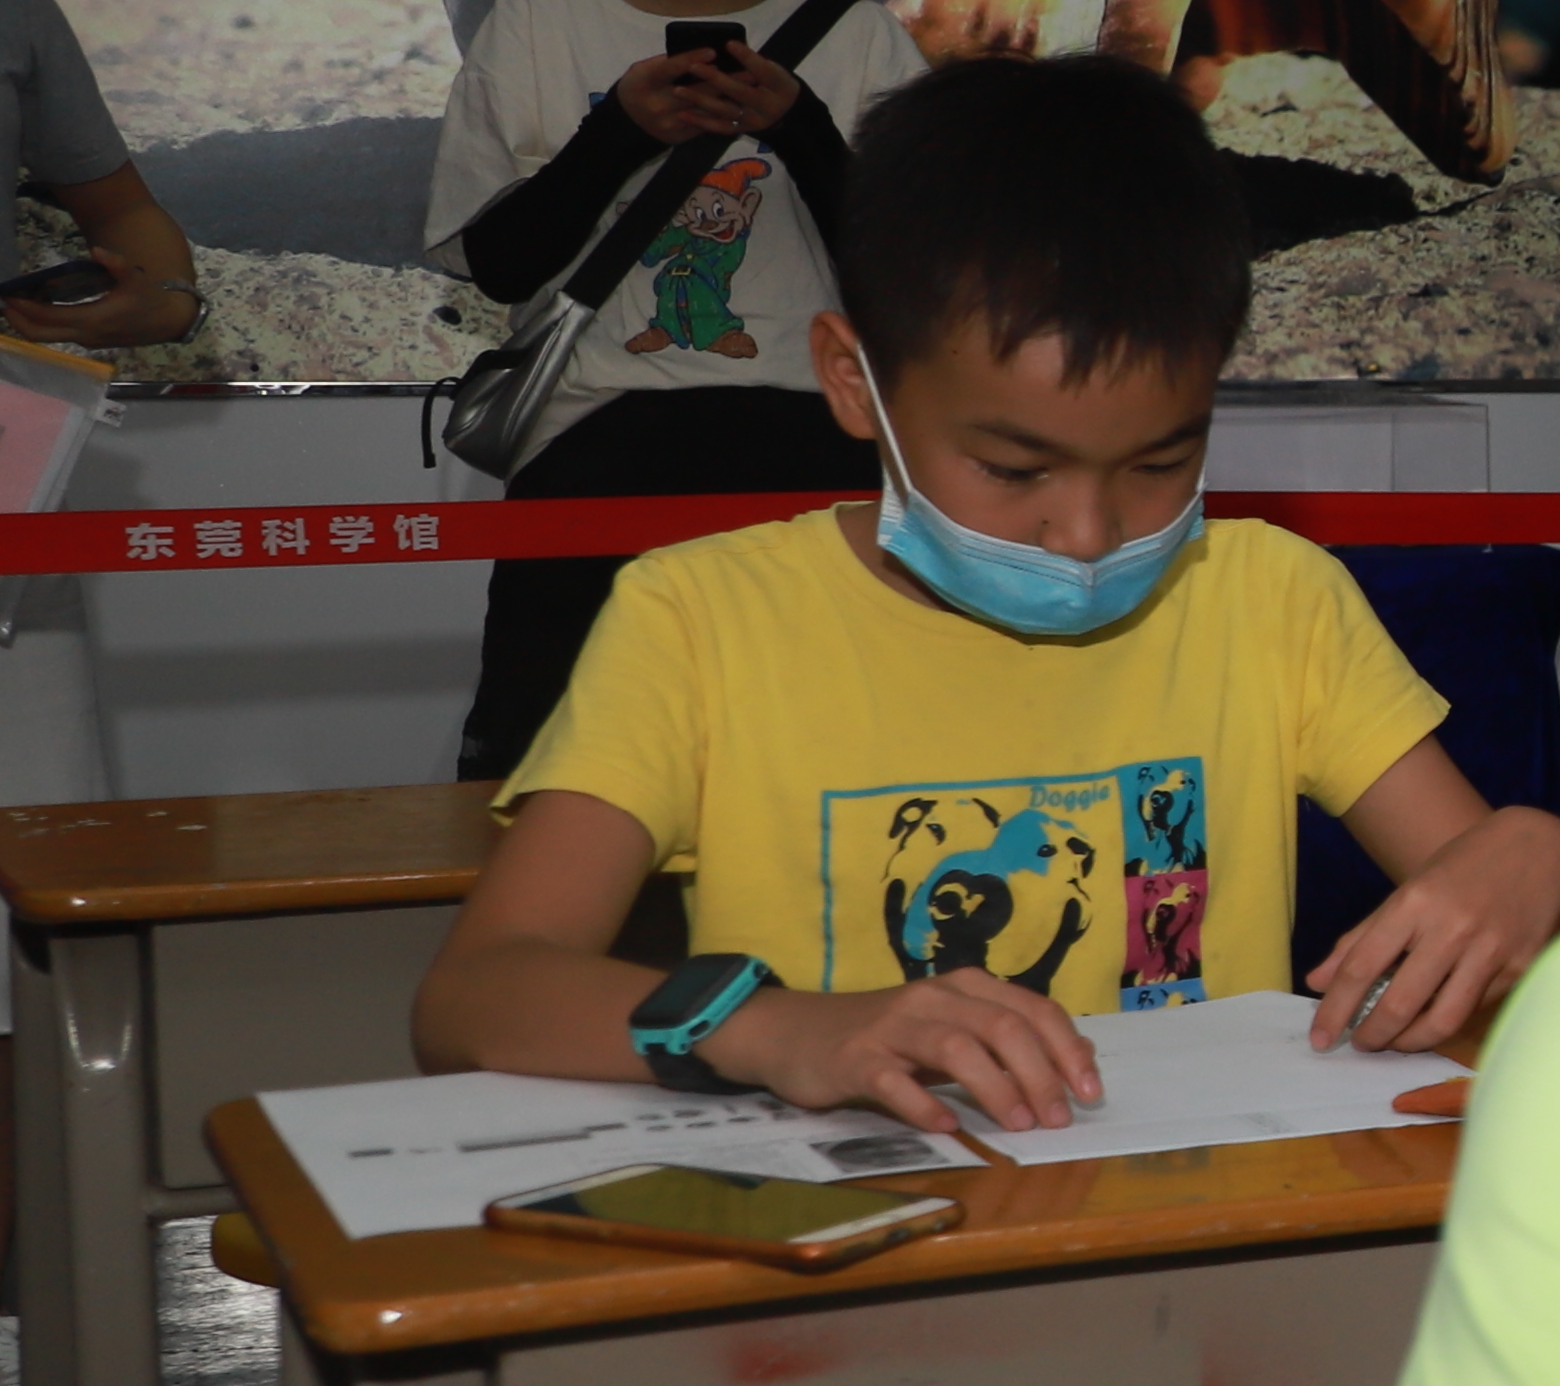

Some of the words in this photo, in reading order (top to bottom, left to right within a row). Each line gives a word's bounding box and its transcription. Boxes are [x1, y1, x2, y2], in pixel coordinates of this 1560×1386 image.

[124, 514, 442, 561] 东莞科学馆
